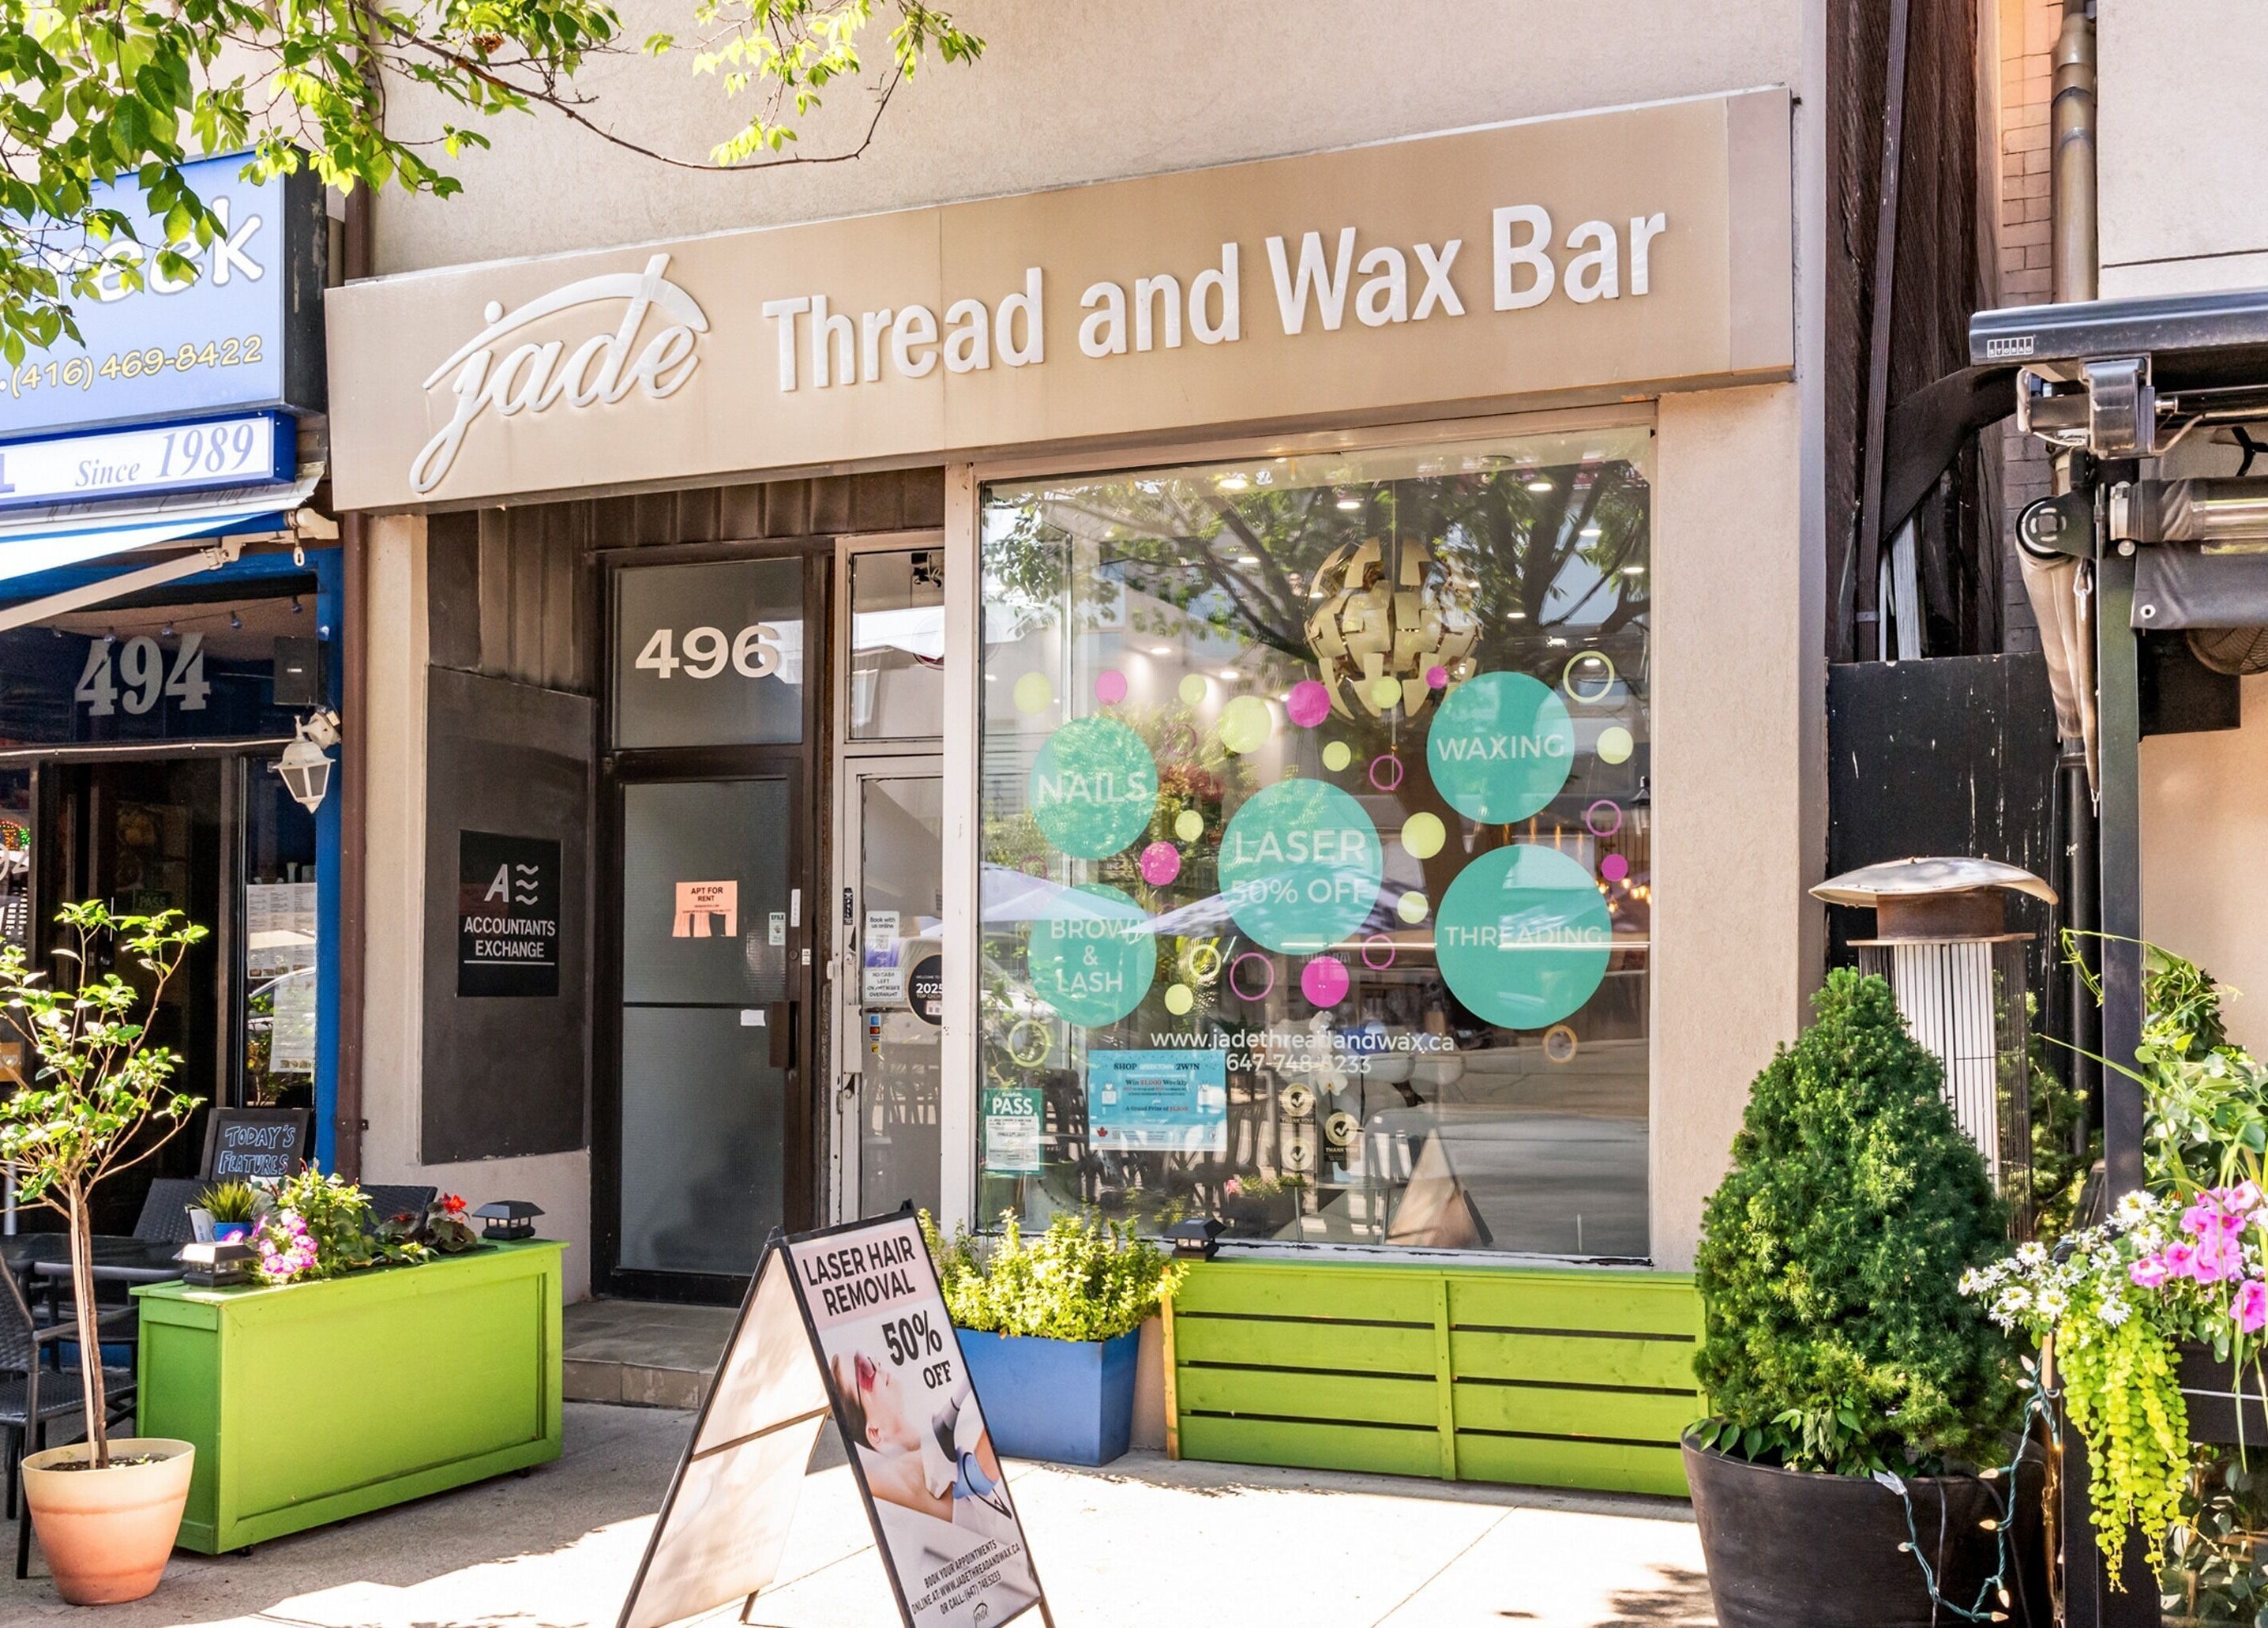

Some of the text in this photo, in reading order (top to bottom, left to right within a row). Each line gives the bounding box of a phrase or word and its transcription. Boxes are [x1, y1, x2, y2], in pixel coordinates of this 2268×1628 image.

[14, 195, 265, 311] reek
[761, 204, 1666, 393] Thread and Wax Bar
[11, 334, 263, 399] (416) 469-8422
[408, 254, 710, 494] jade
[74, 423, 255, 487] Since 1989
[634, 624, 781, 680] 496
[75, 632, 212, 716] 494
[1436, 734, 1565, 761] WAXING
[1037, 771, 1148, 805] NAILS
[1234, 829, 1367, 863] LASER
[1232, 878, 1370, 904] 50% OFF
[464, 916, 556, 937] ACCOUNTANTS
[1444, 926, 1603, 947] THREADING
[475, 940, 545, 958] EXCHANGE
[1083, 944, 1098, 966] &
[1055, 971, 1123, 993] LASH
[1149, 1028, 1455, 1052] www.jadethreadandwax.ca
[992, 1097, 1034, 1115] PASS
[224, 1125, 297, 1150] TODAY'S
[218, 1150, 290, 1176] FEATURES
[802, 1235, 916, 1287] LASER HAIR
[821, 1268, 916, 1317] REMOVAL
[881, 1309, 943, 1367] 50%
[922, 1359, 952, 1389] OFF
[923, 1540, 997, 1589] BOOK YOUR APPOINTMENTS
[911, 1592, 933, 1615] ONLINE
[964, 1585, 980, 1602] (647)
